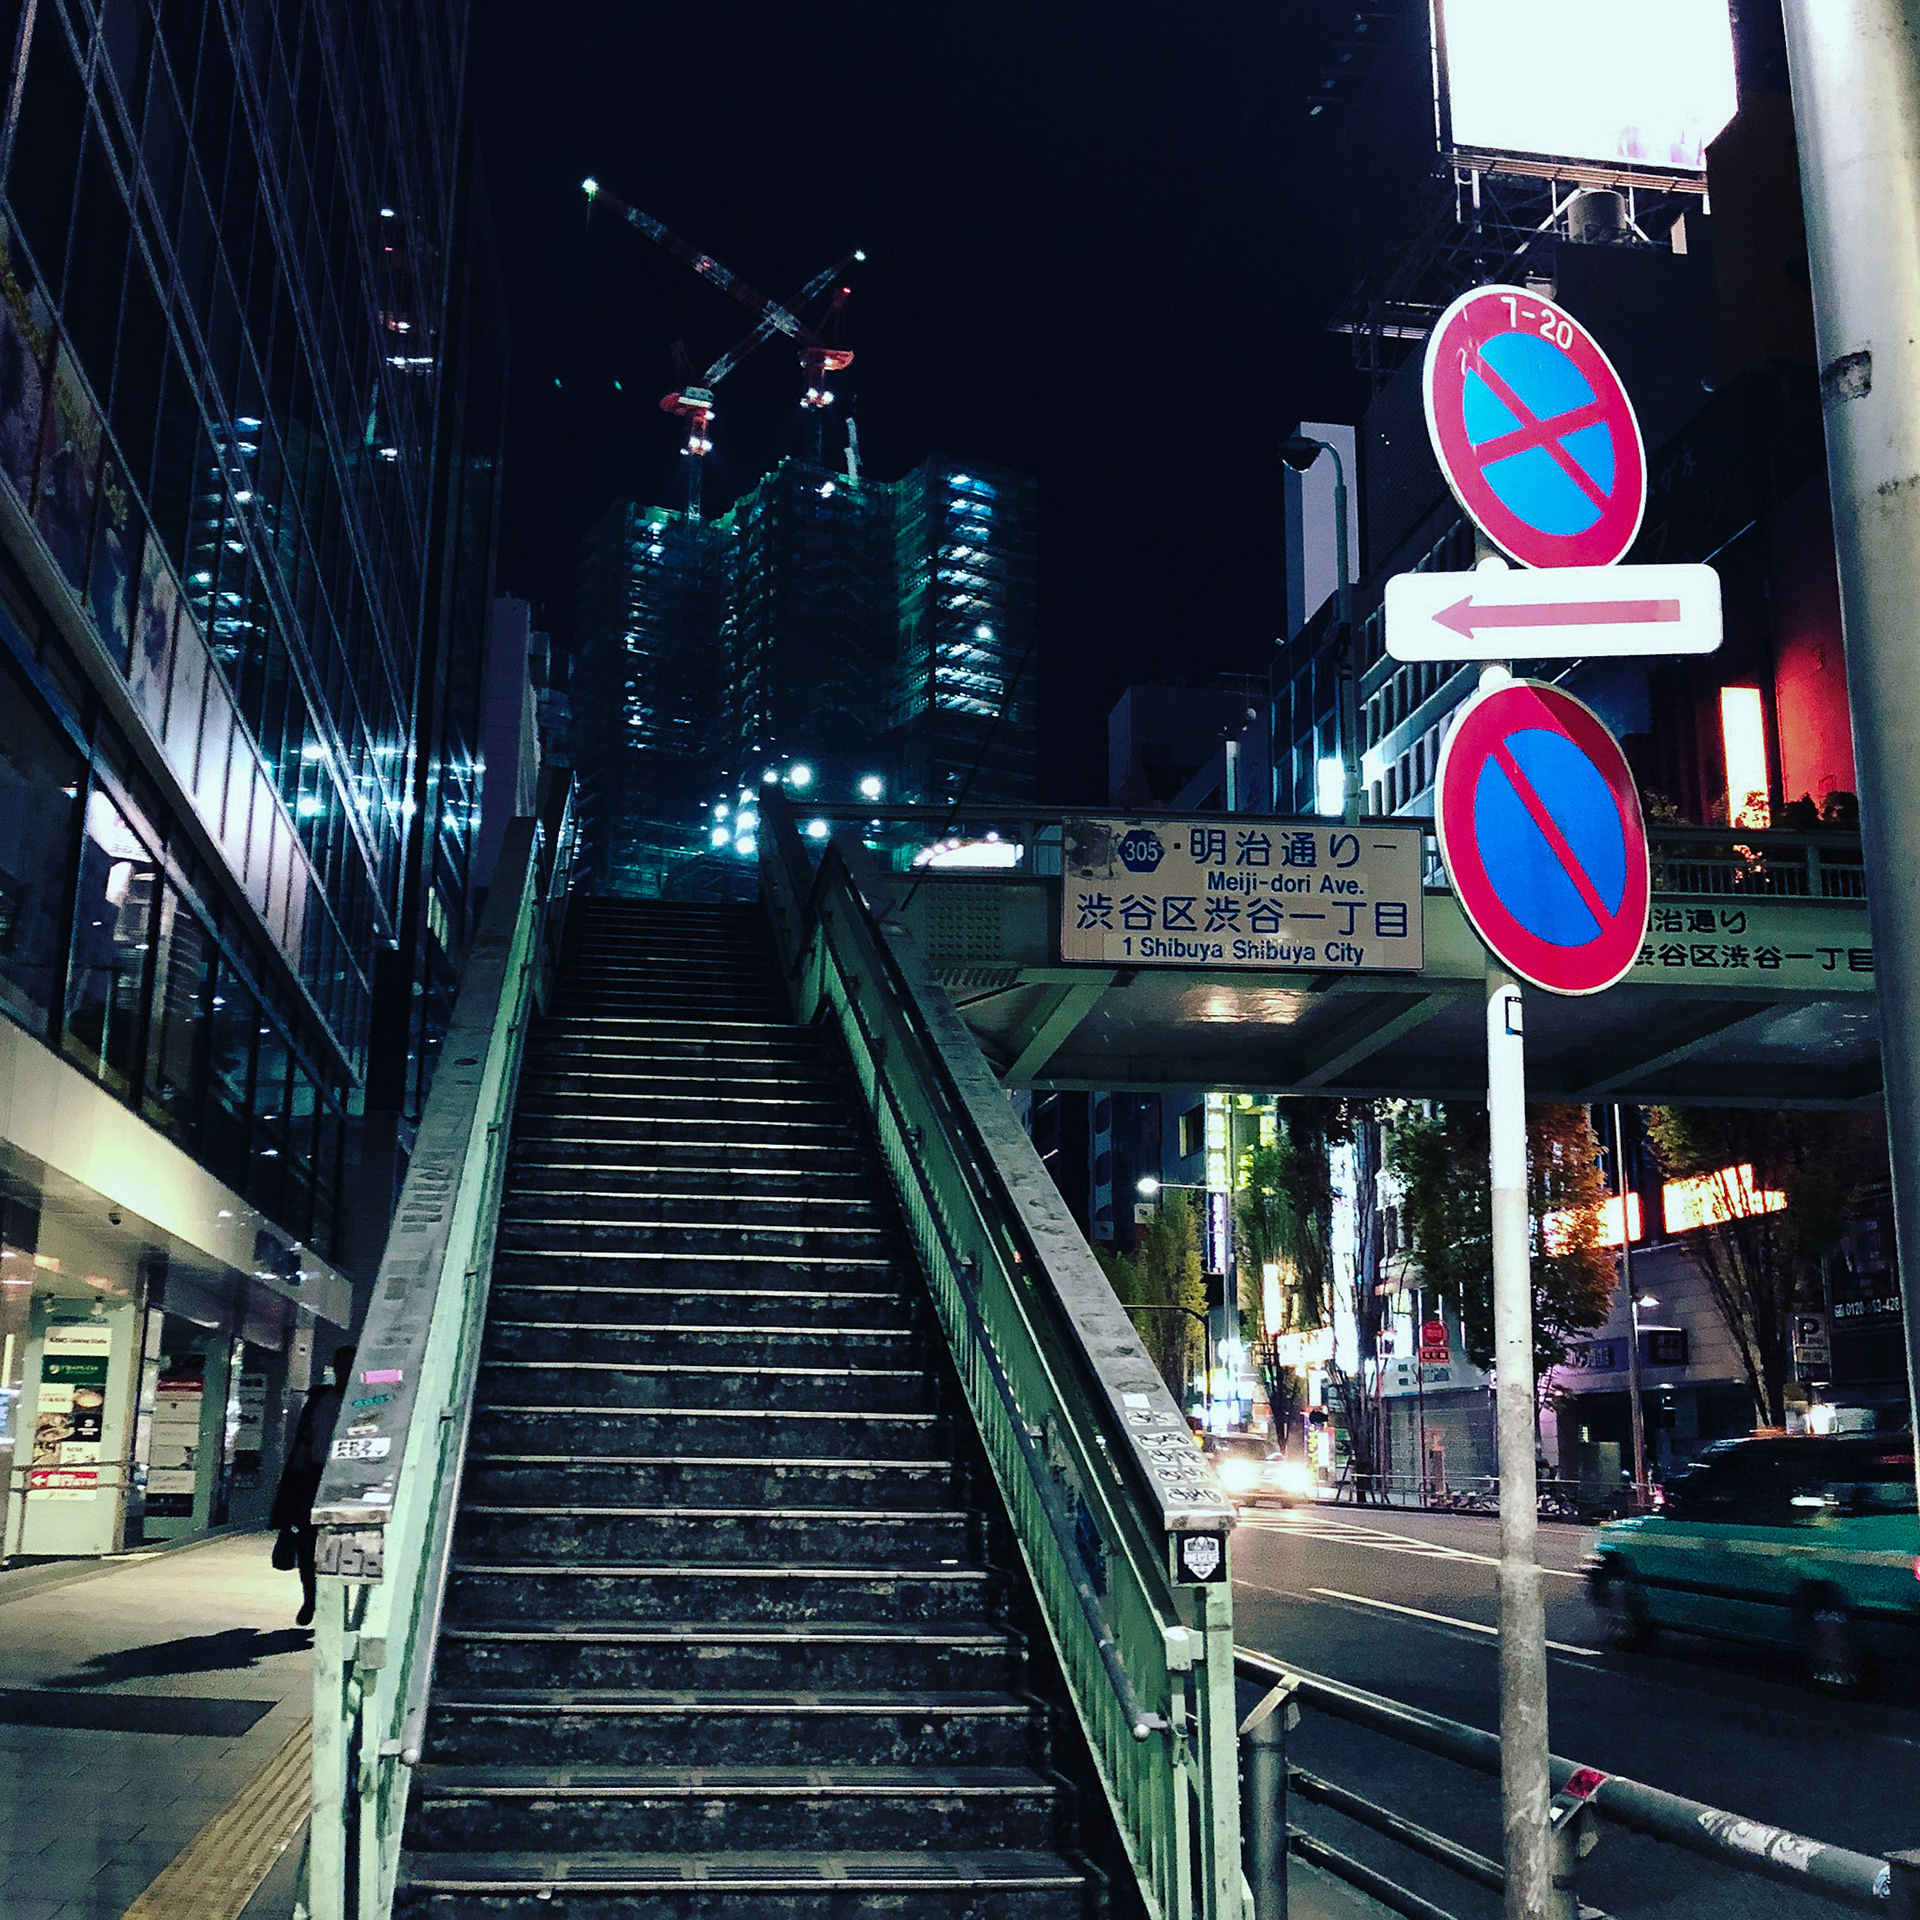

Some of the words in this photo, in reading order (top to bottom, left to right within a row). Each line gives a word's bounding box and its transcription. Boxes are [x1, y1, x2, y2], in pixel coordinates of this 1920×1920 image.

[1499, 296, 1574, 350] 7-20
[1124, 840, 1157, 862] 305
[1207, 871, 1311, 896] Meiji-dori
[1320, 877, 1365, 896] Ave.
[1076, 893, 1408, 939] 渋谷区渋谷一丁目
[1647, 908, 1747, 935] 治通り
[1140, 937, 1223, 961] Shibuya
[1232, 940, 1316, 964] Shibuya
[1324, 943, 1365, 967] City
